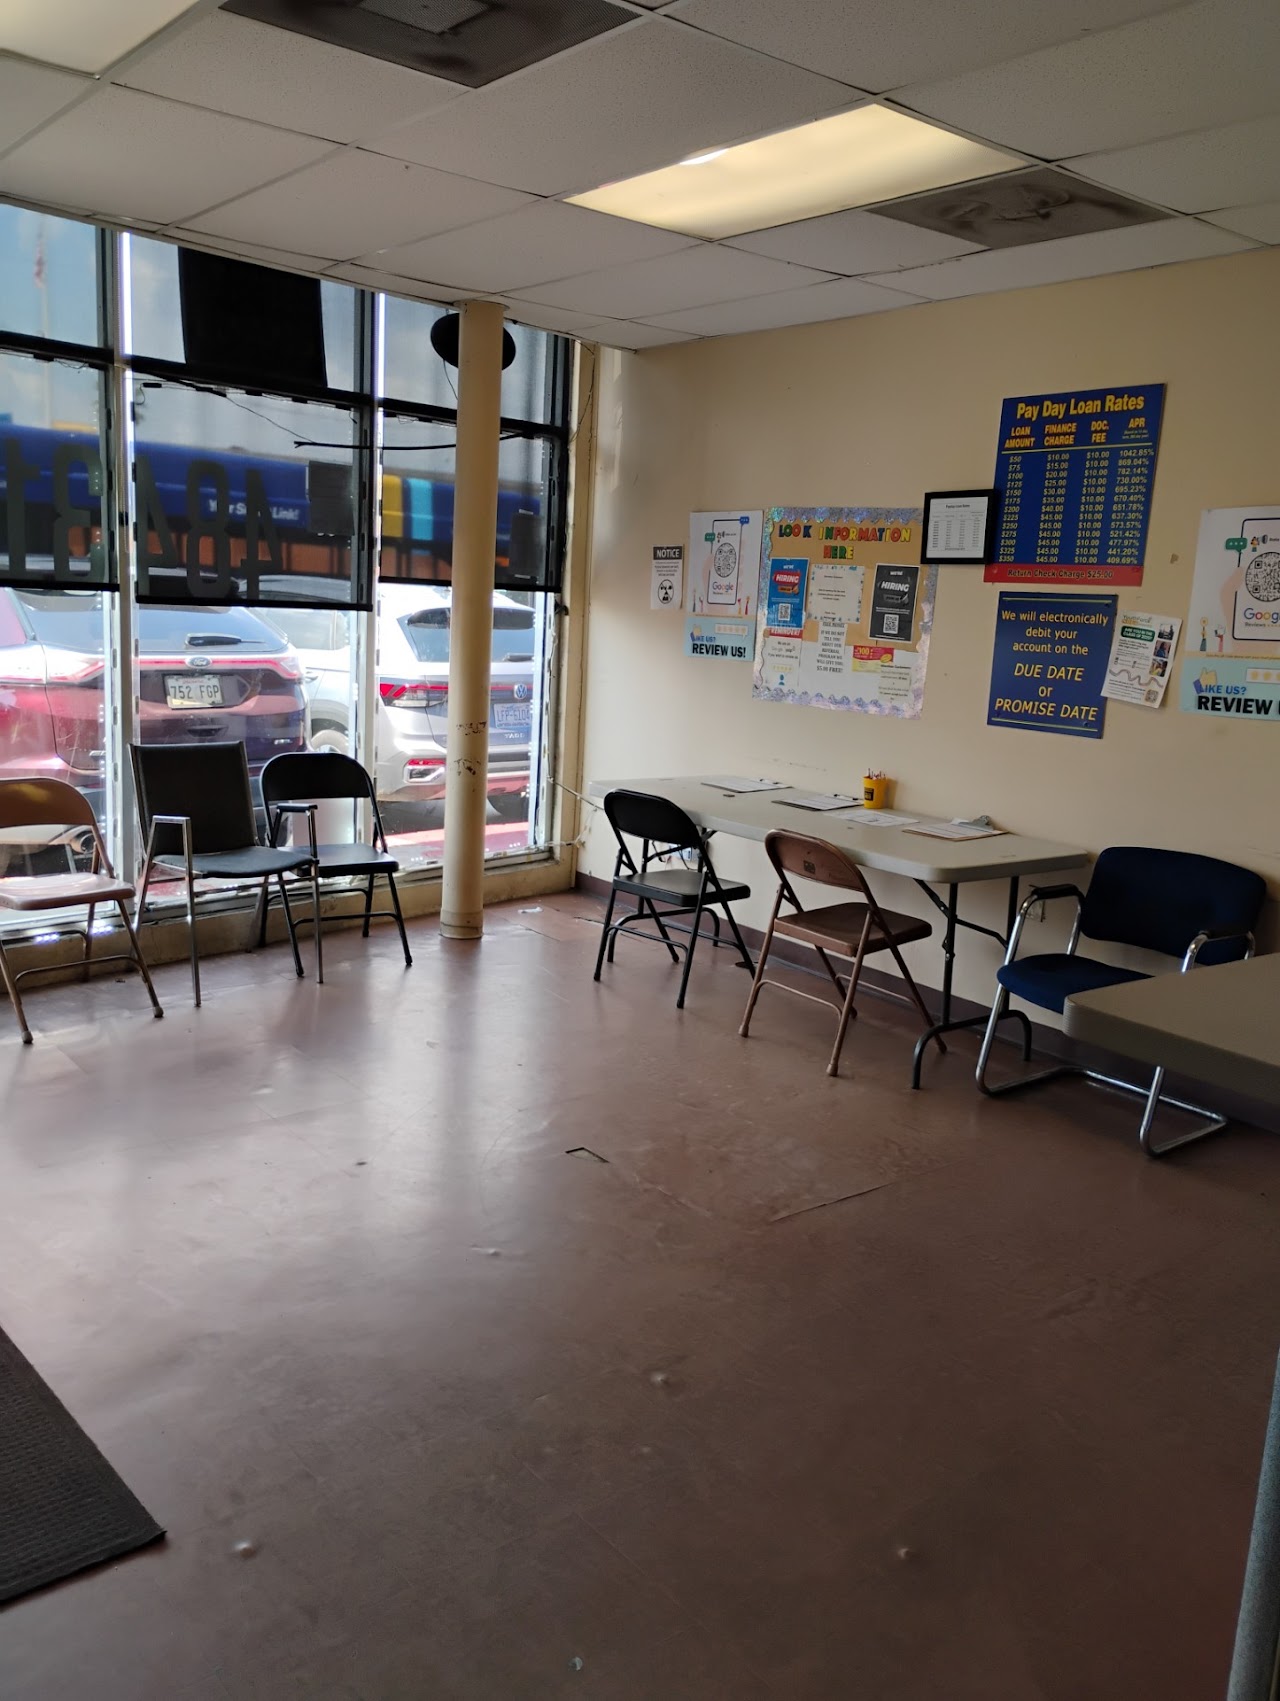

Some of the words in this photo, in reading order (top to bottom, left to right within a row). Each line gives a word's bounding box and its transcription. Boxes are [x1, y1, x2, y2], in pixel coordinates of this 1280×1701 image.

[1016, 402, 1040, 422] Pay
[1042, 400, 1066, 419] Day
[1070, 398, 1101, 415] Loan
[1104, 394, 1145, 412] Rates
[1045, 422, 1077, 434] FINANCE
[1091, 420, 1110, 431] DOC.
[1128, 418, 1146, 428] APR
[1011, 426, 1031, 436] LOAN
[1004, 438, 1035, 448] AMOUNT
[1044, 435, 1075, 446] CHARGE
[1092, 433, 1106, 443] FEE
[1086, 451, 1109, 459] $10.00
[1084, 468, 1107, 476] $10.00
[1084, 477, 1106, 485] $10.00
[1044, 487, 1065, 495] $30.00
[1082, 486, 1105, 494] $10.00
[208, 499, 234, 514] Yr
[1042, 504, 1063, 512] $40.00
[1080, 512, 1102, 520] $10.00
[778, 524, 812, 538] LOOK
[819, 526, 911, 542] INFORMATION
[1076, 538, 1099, 546] $10.00
[657, 549, 680, 558] NOTICE
[823, 545, 854, 559] HERE
[1076, 547, 1098, 555] $10.00
[776, 574, 799, 583] HIRING
[1008, 569, 1032, 577] Return
[1034, 569, 1055, 577] Check
[1059, 570, 1084, 579] Charge
[1088, 570, 1113, 578] $25.00
[712, 582, 734, 596] Google
[881, 581, 910, 592] HIRING
[1002, 610, 1016, 620] We
[1020, 611, 1036, 620] will
[1040, 612, 1108, 626] electronically
[1244, 608, 1280, 624] Goog
[1026, 627, 1052, 638] debit
[1055, 630, 1078, 640] your
[692, 643, 728, 656] REVIEW
[731, 647, 746, 658] US!
[1012, 642, 1052, 653] account
[1054, 645, 1068, 654] on
[1072, 644, 1089, 655] the
[1014, 663, 1043, 678] DUE
[1047, 665, 1085, 681] DATE
[170, 686, 193, 699] 752
[200, 685, 219, 698] FGP
[1038, 686, 1053, 697] or
[1226, 685, 1247, 695] US?
[994, 698, 1056, 716] PROMISE
[1060, 704, 1098, 721] DATE
[1198, 696, 1273, 715] REVIEW
